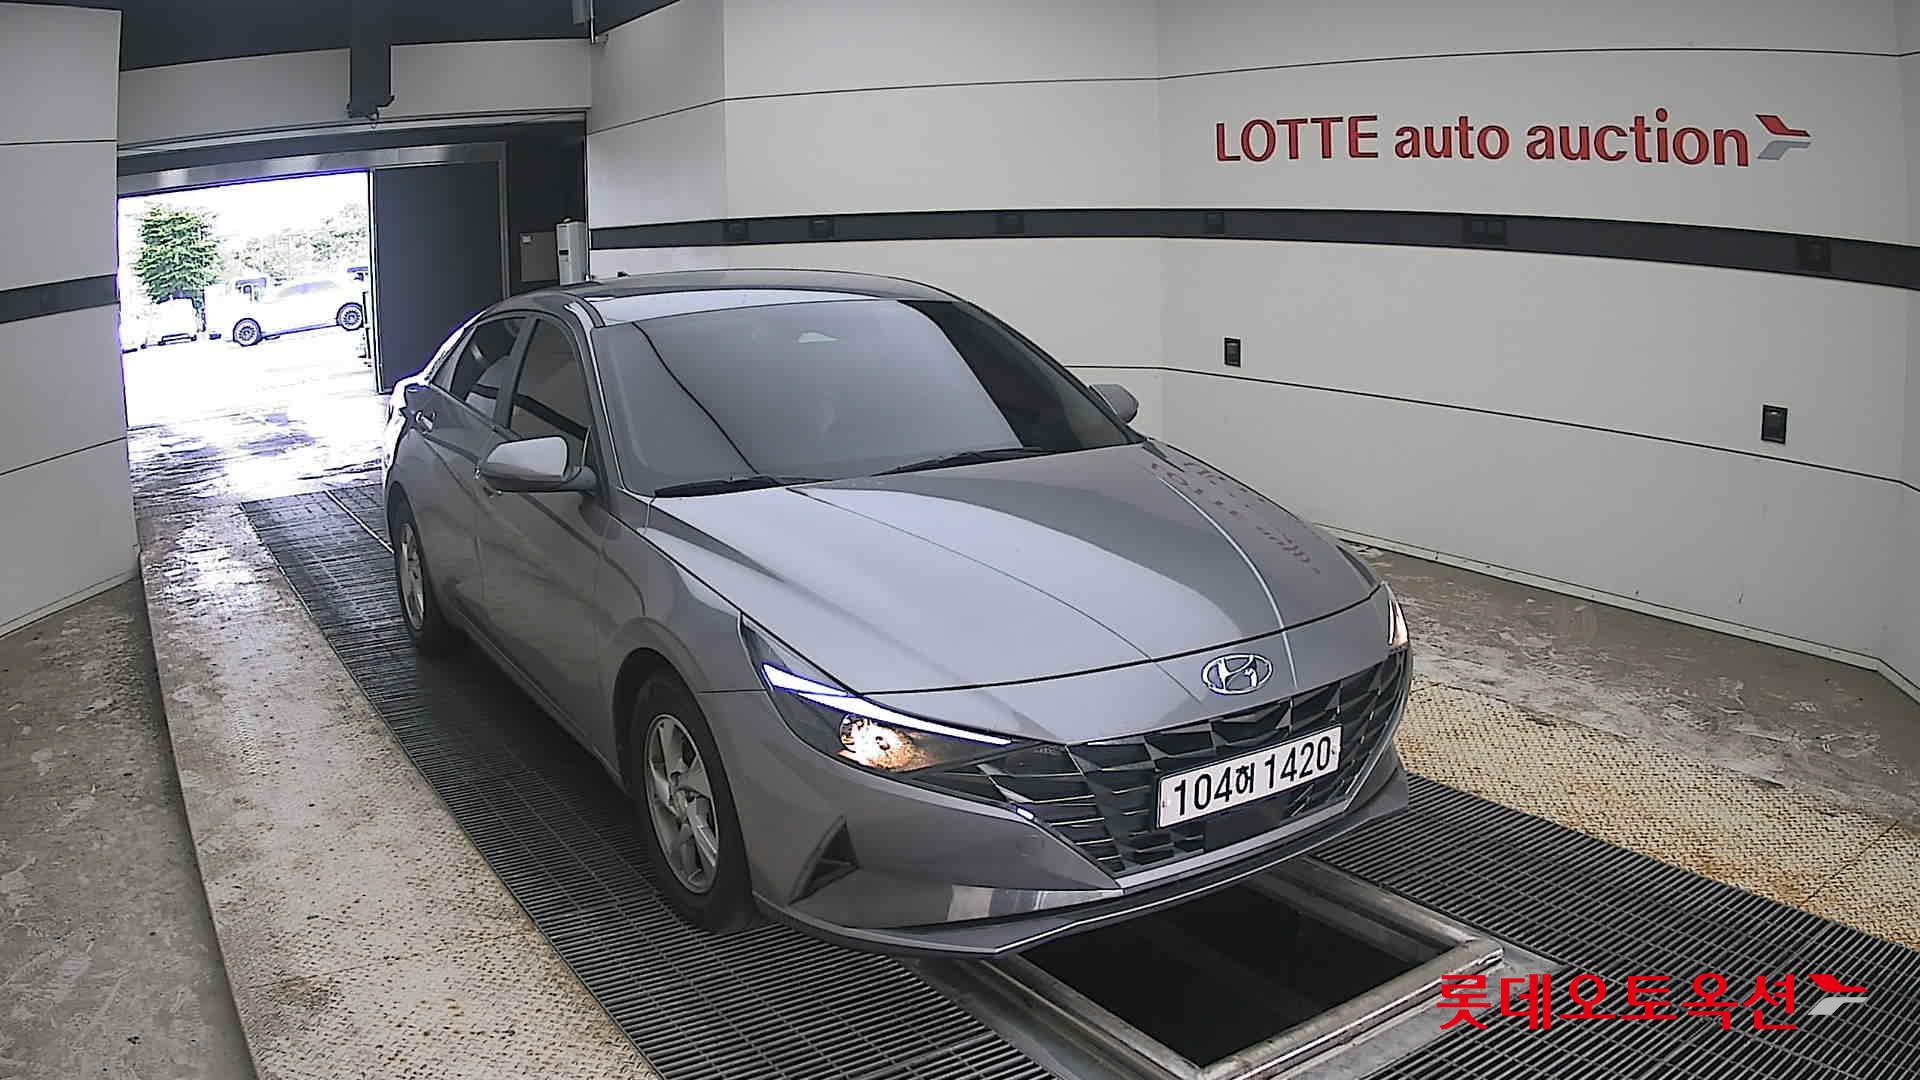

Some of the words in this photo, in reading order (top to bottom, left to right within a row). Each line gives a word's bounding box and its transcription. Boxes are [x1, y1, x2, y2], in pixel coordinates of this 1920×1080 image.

[1216, 115, 1378, 162] LOTTE
[1394, 116, 1509, 159] auto
[1526, 108, 1750, 167] auction
[1175, 763, 1255, 815] 104허
[1264, 736, 1331, 788] 1420
